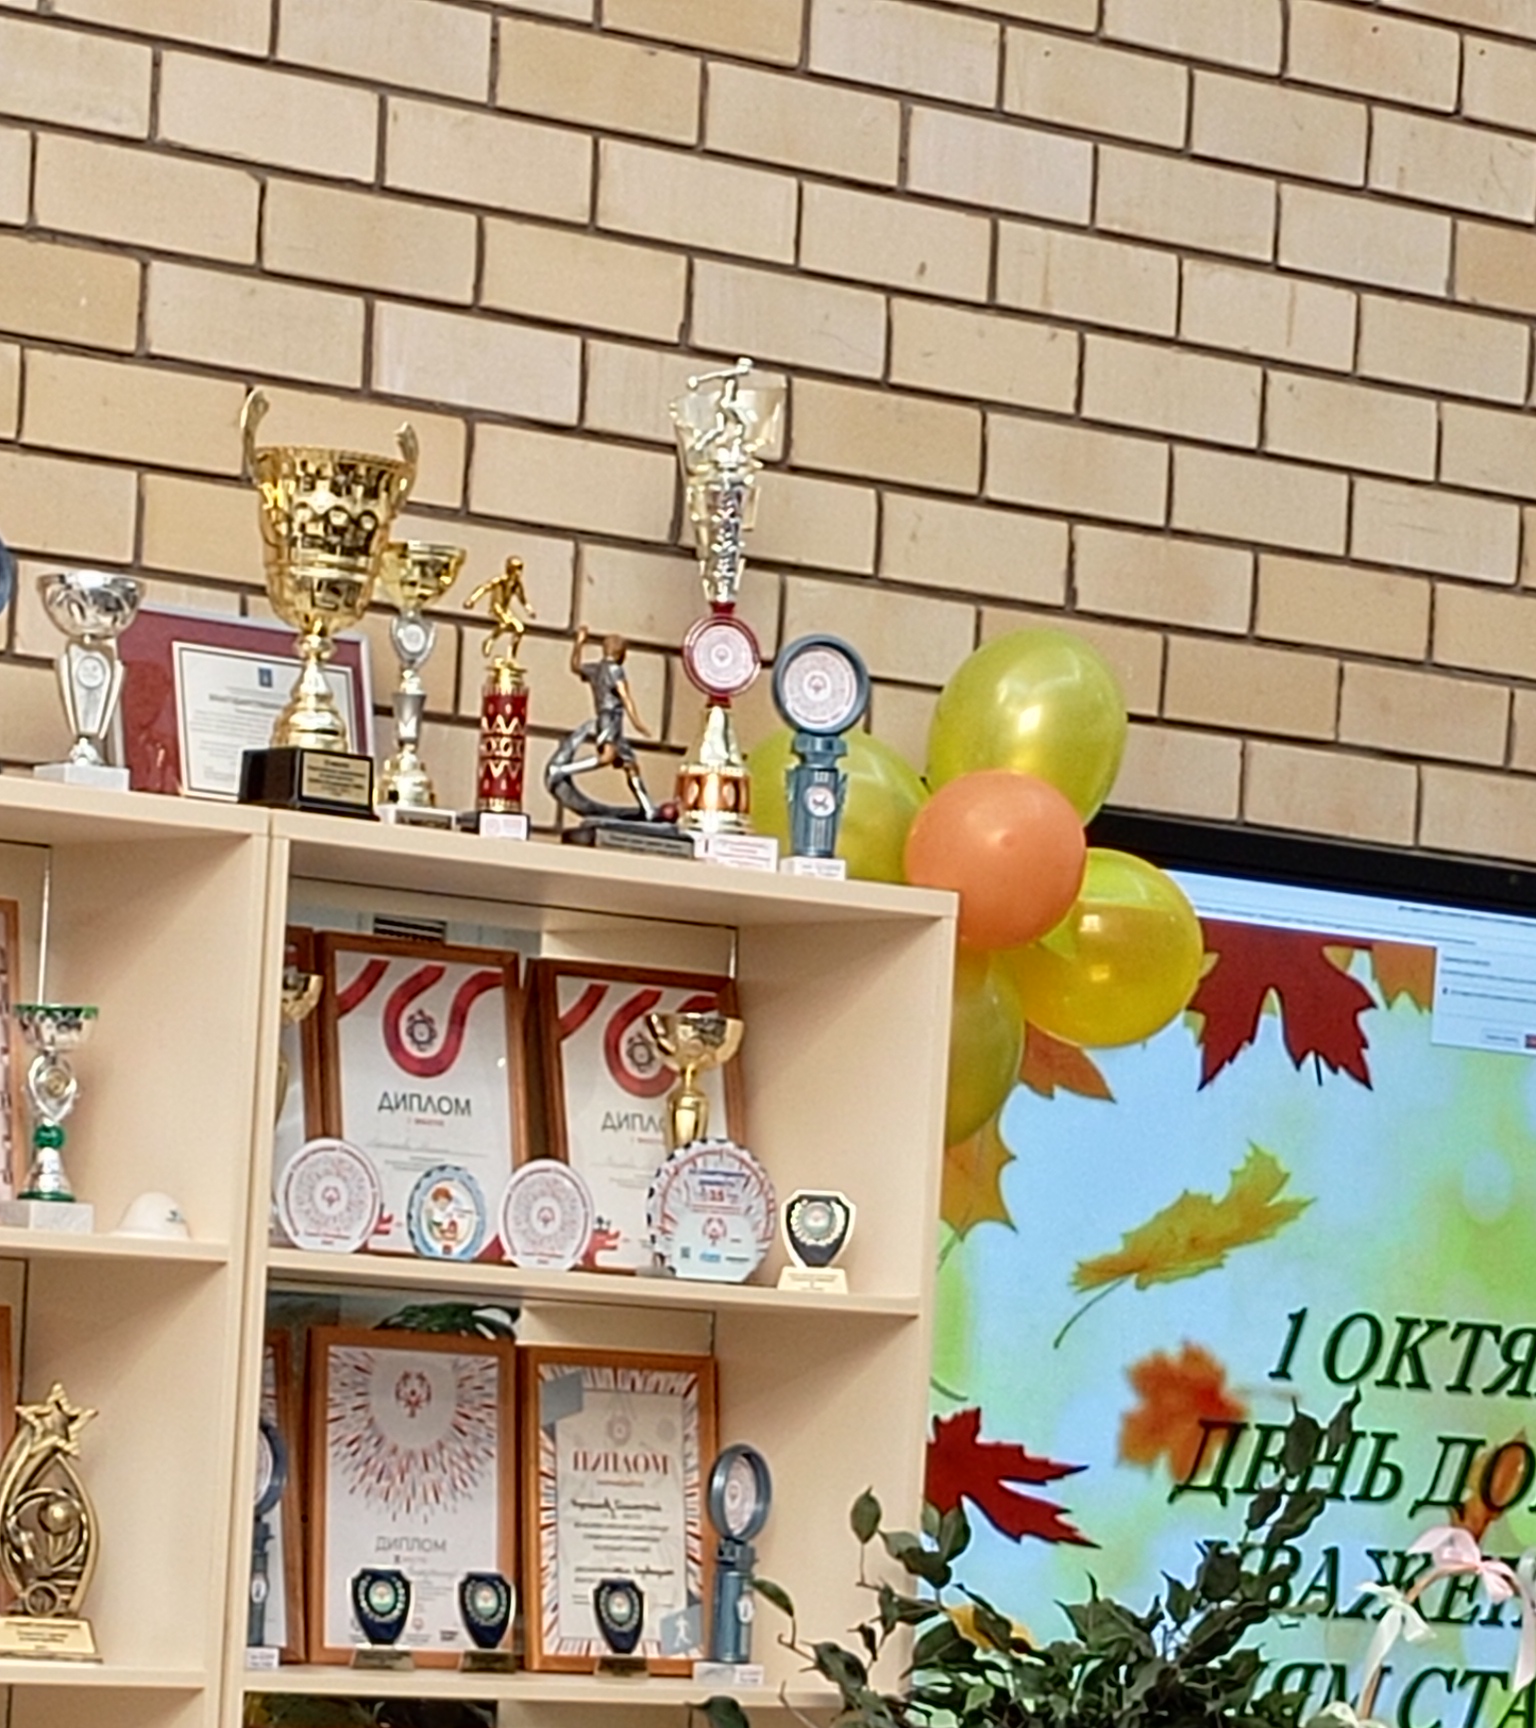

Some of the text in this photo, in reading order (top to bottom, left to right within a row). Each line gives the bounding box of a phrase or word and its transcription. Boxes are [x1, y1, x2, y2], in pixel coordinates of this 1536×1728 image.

[378, 1090, 472, 1117] ДИПЛОМ
[601, 1111, 666, 1133] ДИПЛ
[1268, 1306, 1309, 1381] 1
[1167, 1418, 1404, 1507] ДЕНЬ
[375, 1535, 447, 1553] ДИПЛОМ
